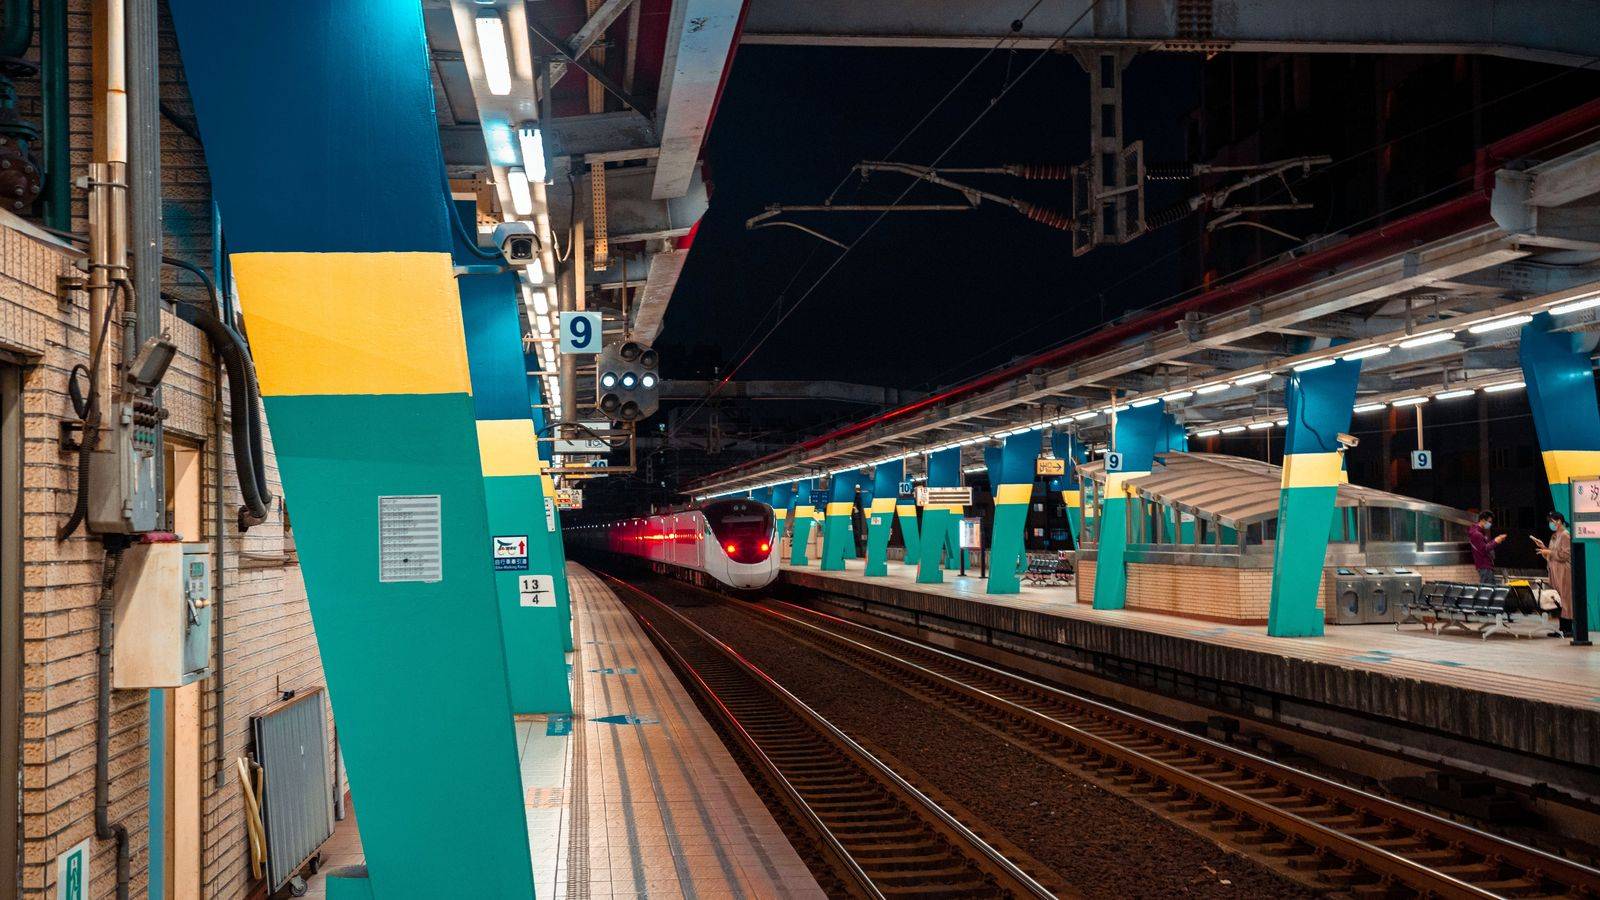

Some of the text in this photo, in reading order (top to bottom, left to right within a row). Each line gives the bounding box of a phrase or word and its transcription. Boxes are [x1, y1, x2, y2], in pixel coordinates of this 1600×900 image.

[570, 316, 592, 349] 9
[1109, 454, 1119, 469] 9
[1418, 453, 1428, 467] 9
[900, 483, 910, 493] 10
[523, 579, 539, 590] 13
[532, 594, 539, 605] 4
